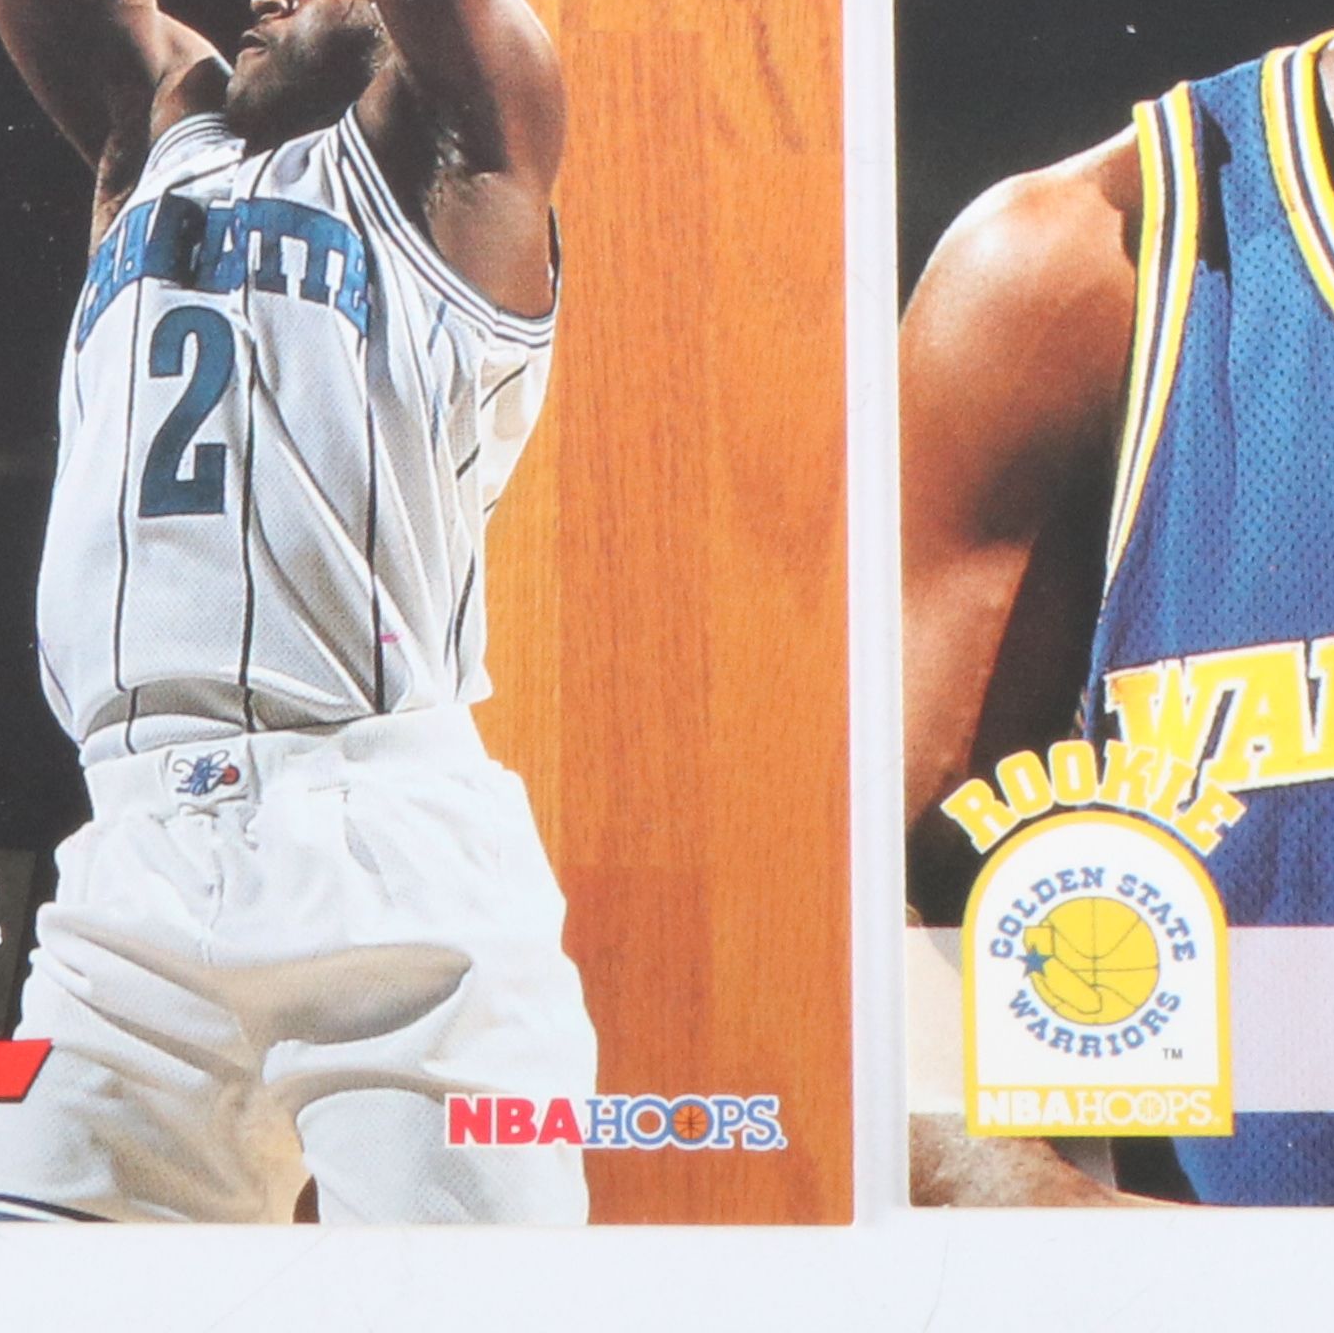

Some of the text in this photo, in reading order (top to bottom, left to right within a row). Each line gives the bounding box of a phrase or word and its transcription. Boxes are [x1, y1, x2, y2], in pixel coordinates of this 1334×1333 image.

[137, 304, 237, 519] 2
[939, 739, 1248, 856] ROOKIE
[989, 866, 1197, 963] GOLDEN STATE
[1008, 989, 1183, 1059] WARRIORS
